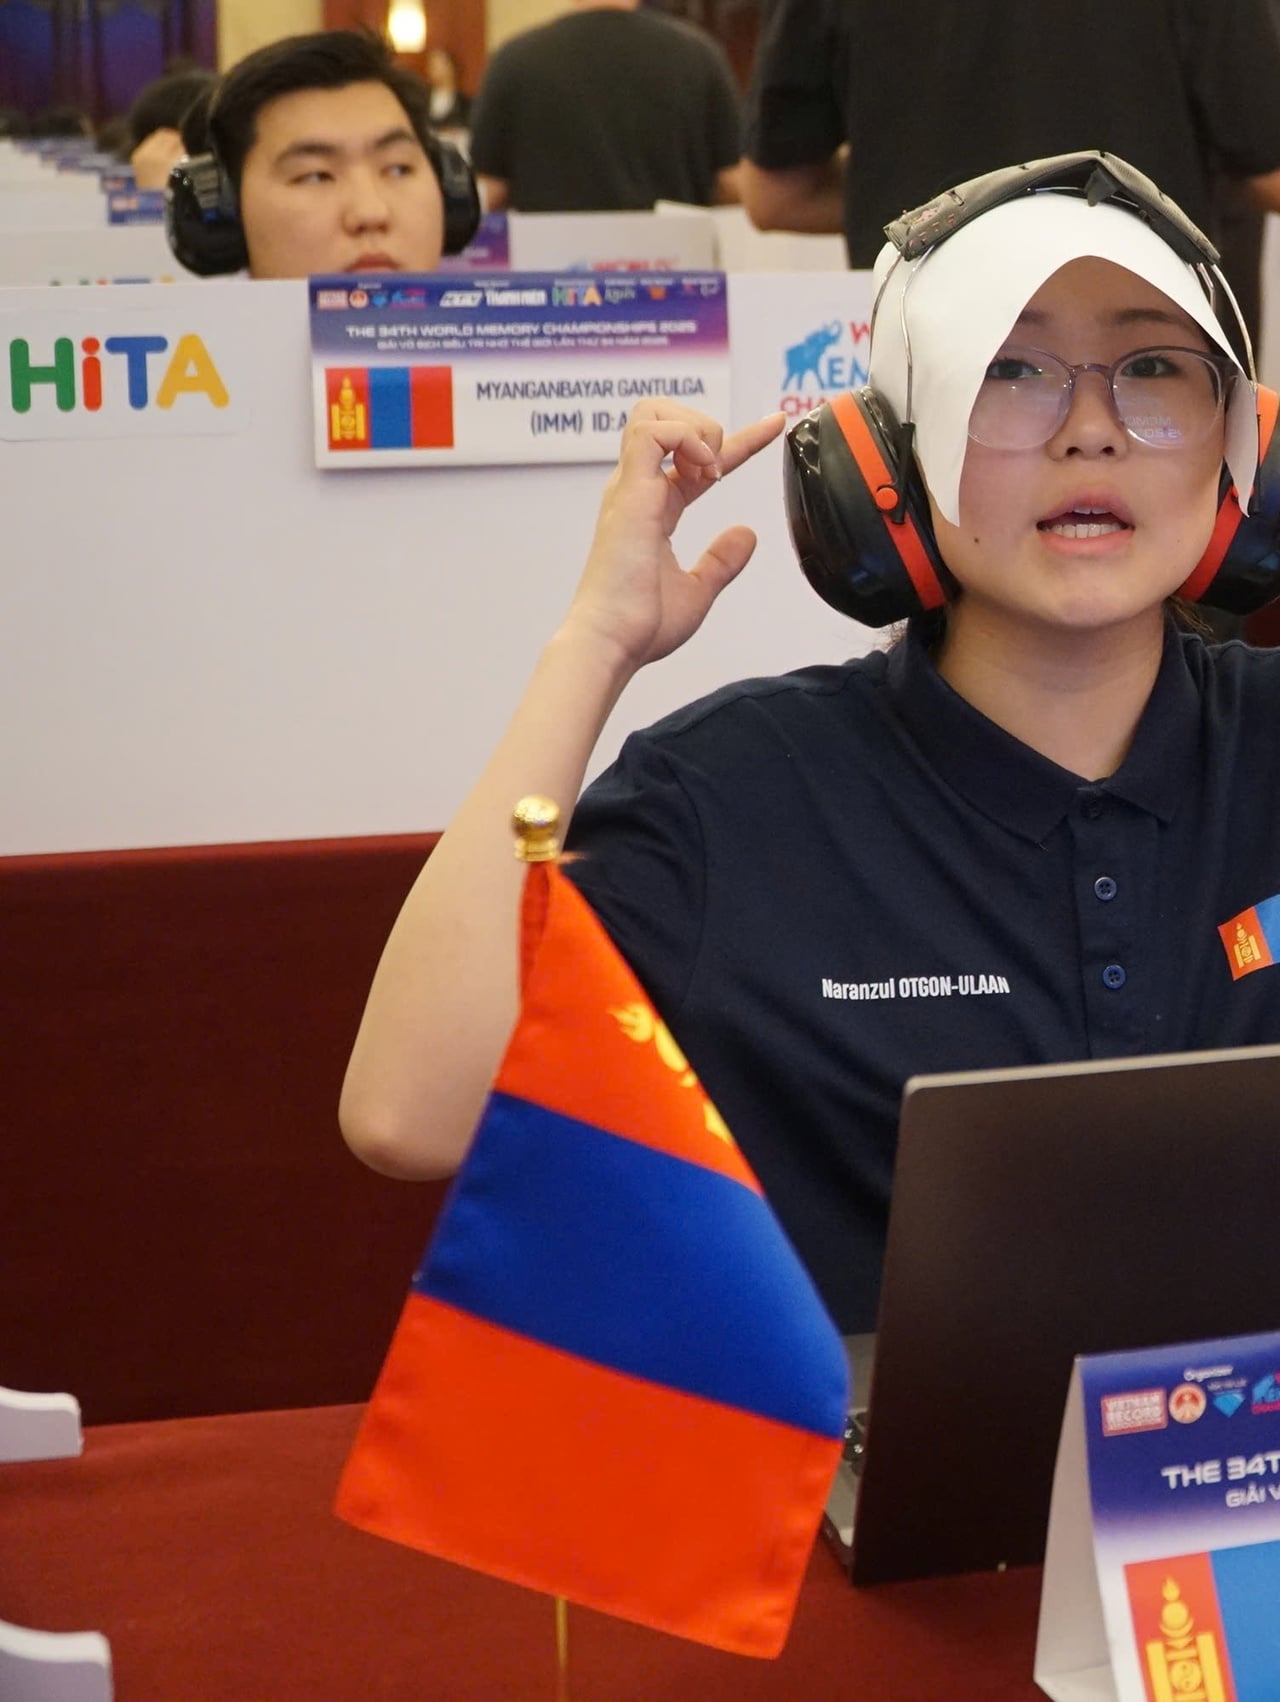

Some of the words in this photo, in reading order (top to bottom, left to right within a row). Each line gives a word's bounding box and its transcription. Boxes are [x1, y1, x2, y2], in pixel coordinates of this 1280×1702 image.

[420, 323, 473, 336] WORLD
[476, 322, 539, 336] MEMORY
[10, 333, 230, 414] HiTA
[476, 380, 613, 400] MYANGANBAYAR
[617, 377, 705, 397] GANTULGA
[530, 409, 584, 436] (IMM)
[821, 978, 895, 1001] Naranzul
[898, 974, 1011, 998] OTGON-ULAAN
[1161, 1461, 1222, 1490] THE
